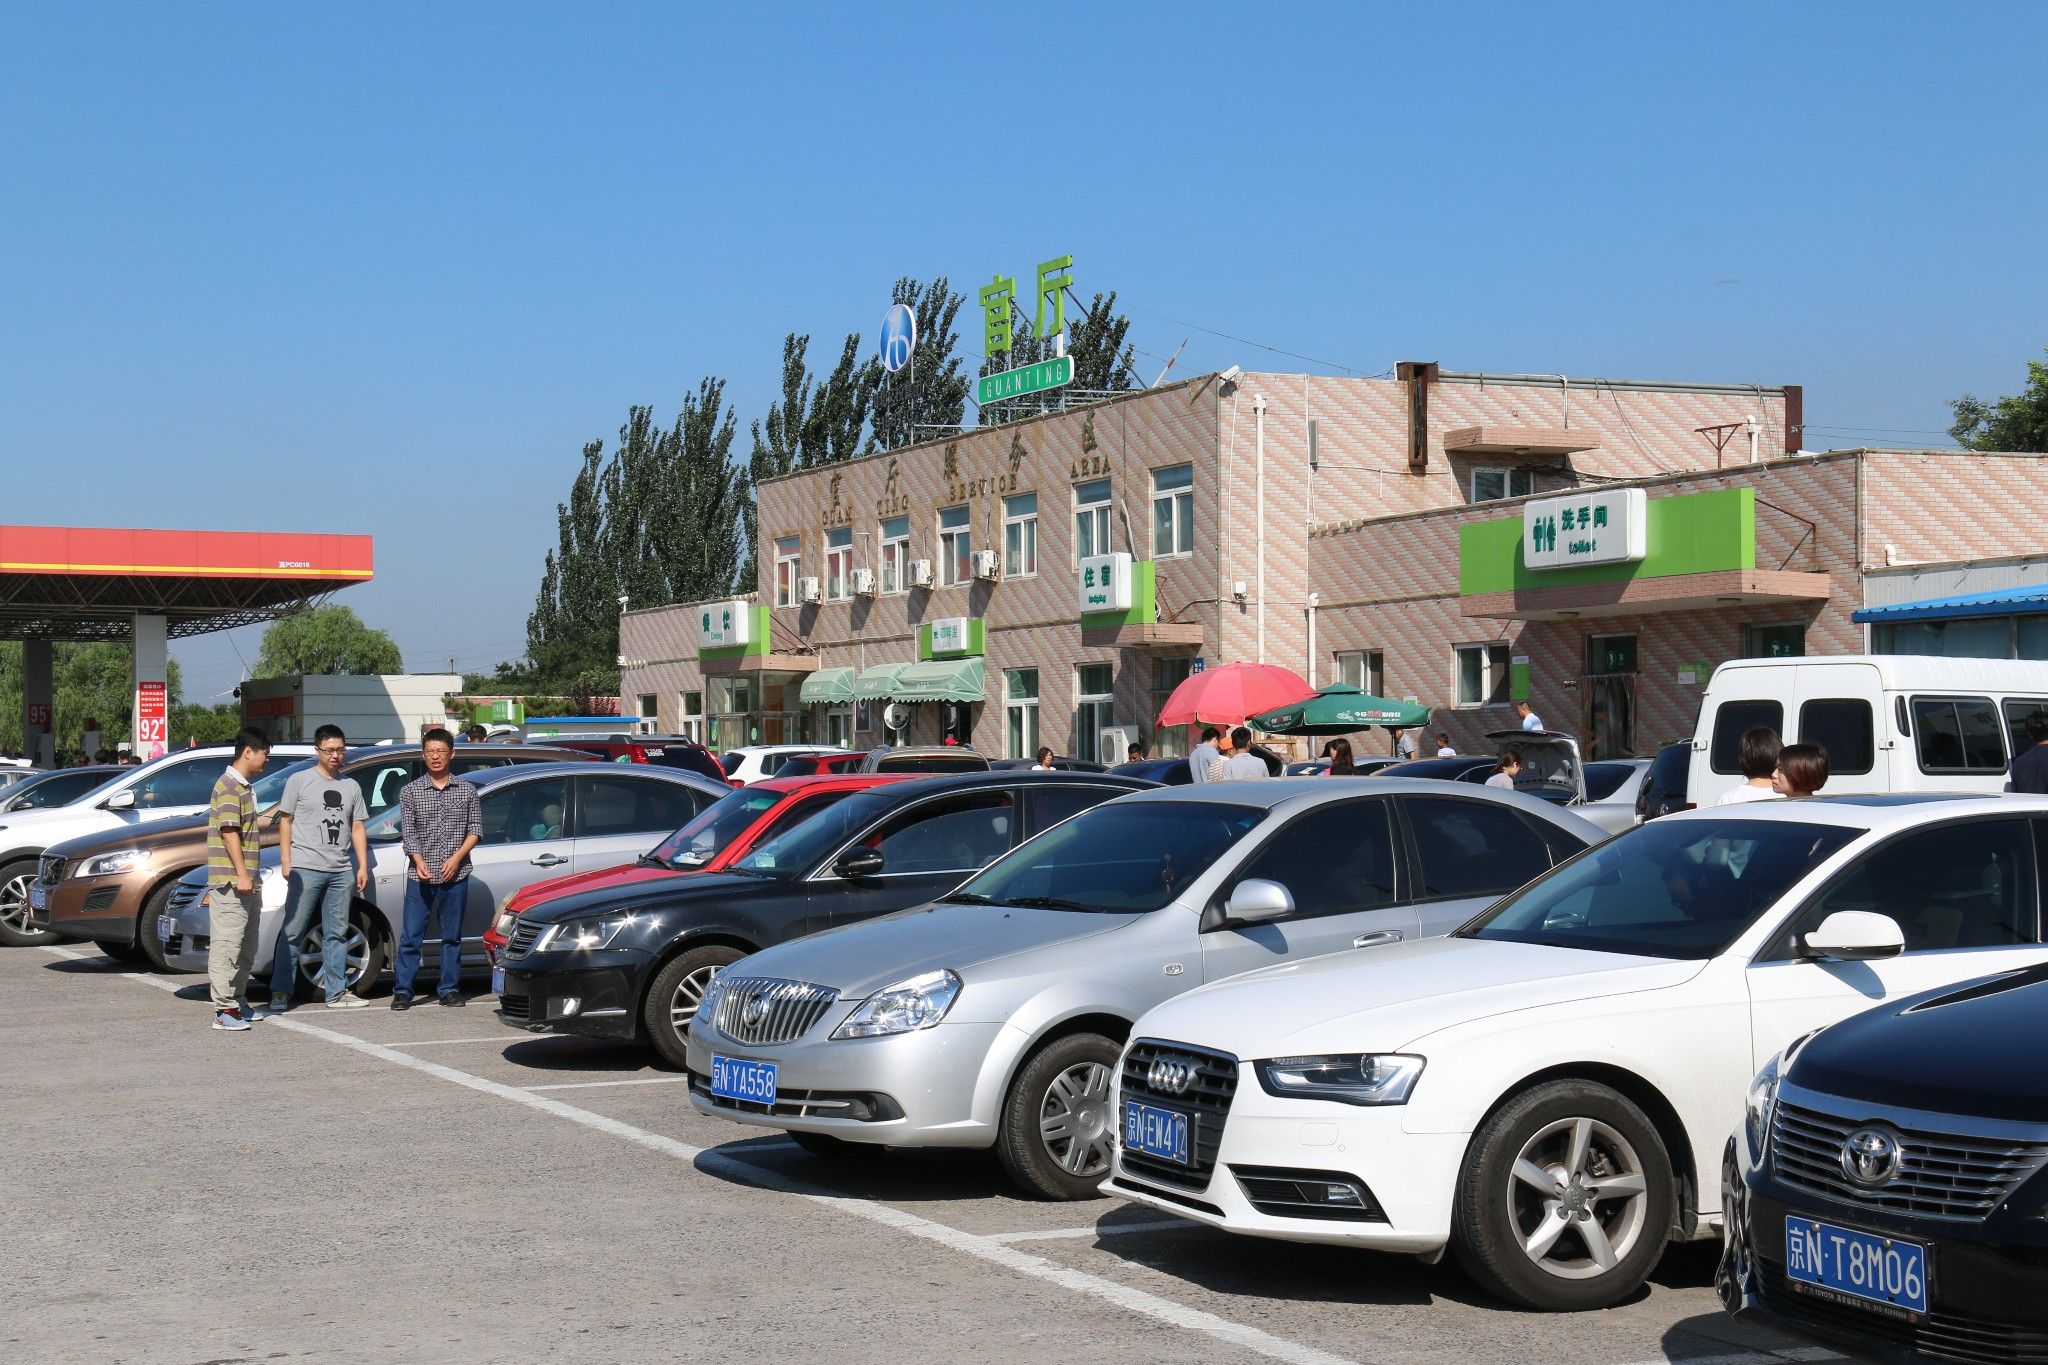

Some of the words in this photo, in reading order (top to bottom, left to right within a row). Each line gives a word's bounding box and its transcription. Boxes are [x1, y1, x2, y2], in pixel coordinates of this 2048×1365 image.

[979, 255, 1073, 359] 官厅
[986, 362, 1063, 398] GUANTING
[1561, 505, 1608, 531] 洗手间
[1568, 539, 1597, 554] toilet
[1084, 564, 1111, 589] 住宿
[1815, 1289, 1835, 1299] TOYOTA
